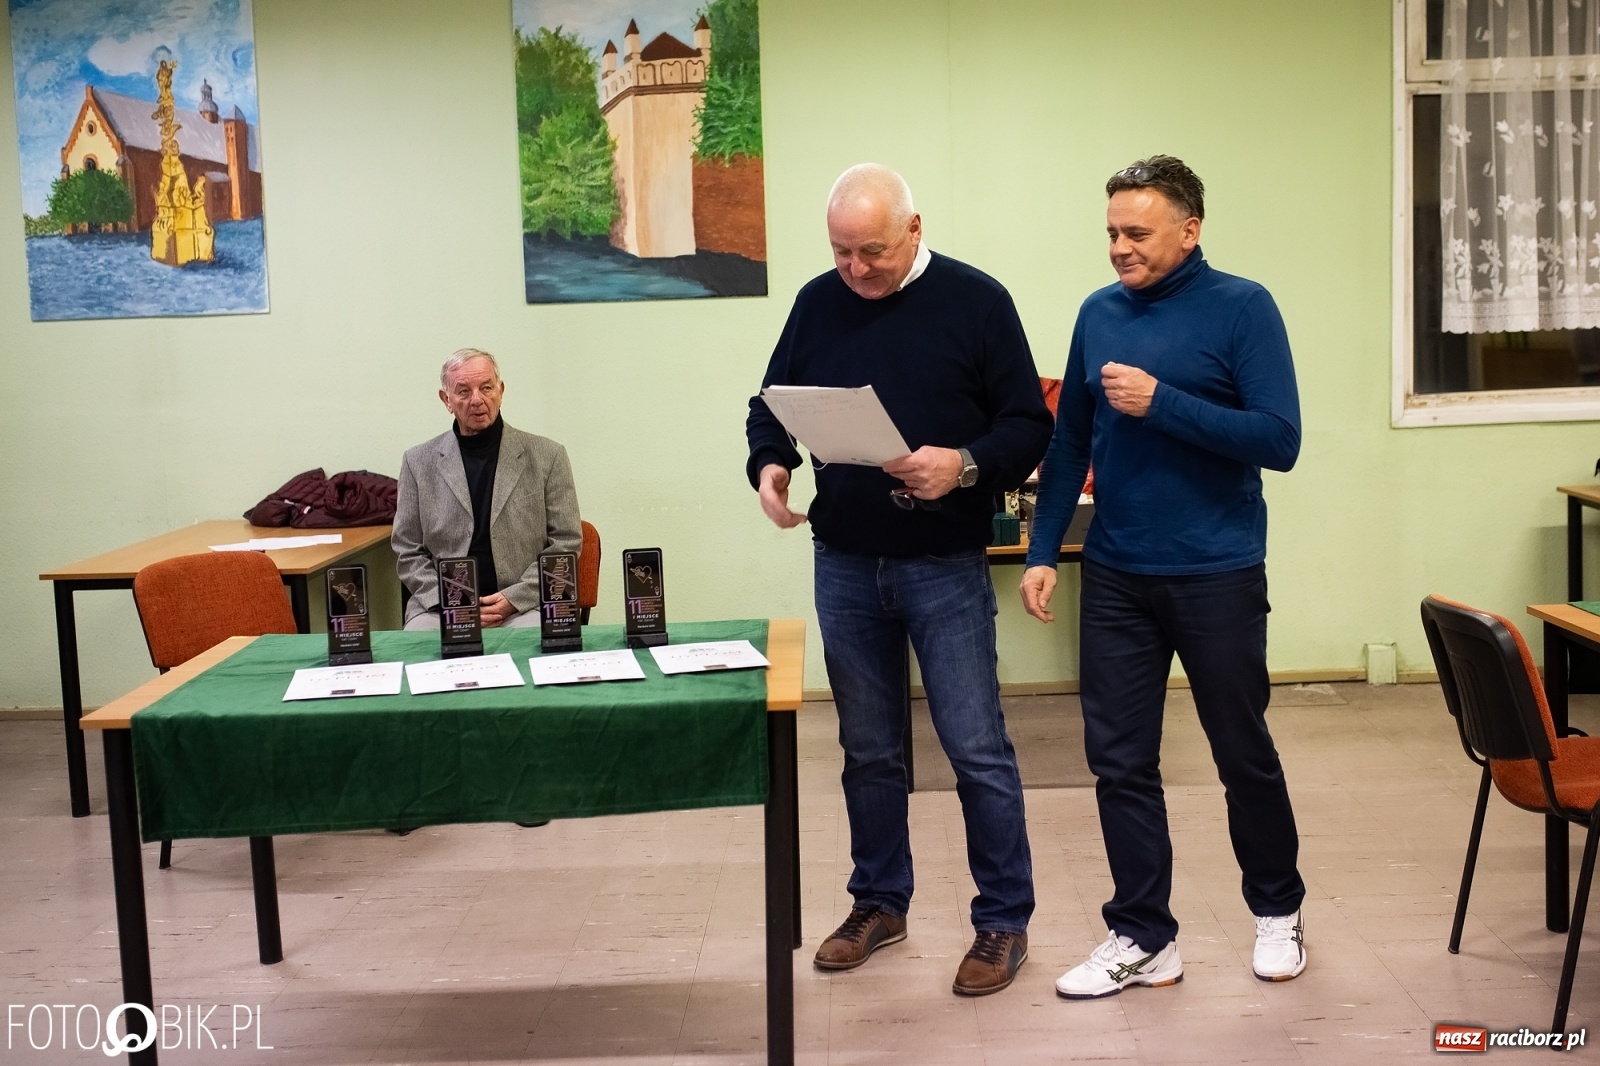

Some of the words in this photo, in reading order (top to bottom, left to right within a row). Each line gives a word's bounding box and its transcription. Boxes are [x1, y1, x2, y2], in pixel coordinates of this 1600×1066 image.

[543, 604, 556, 618] 11
[628, 600, 641, 614] 11
[443, 610, 456, 624] 11
[331, 618, 344, 633] 11
